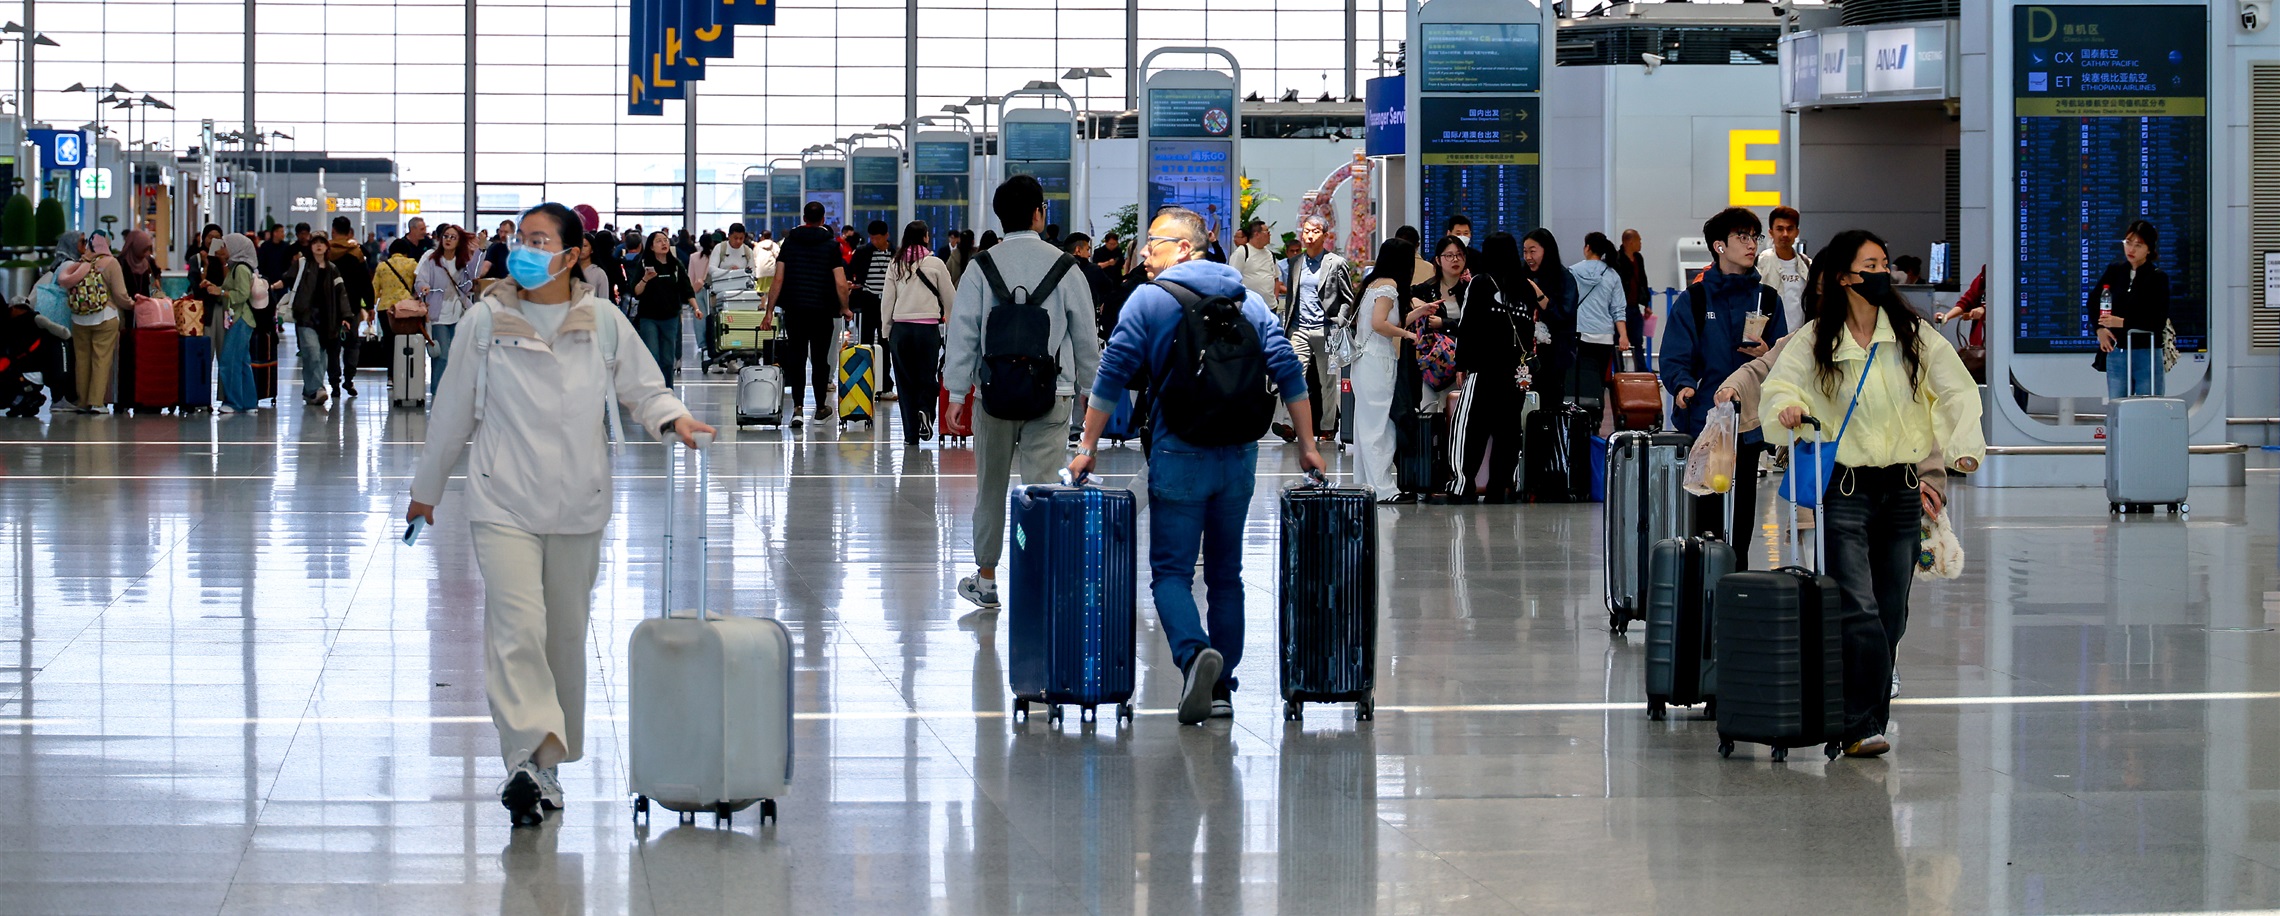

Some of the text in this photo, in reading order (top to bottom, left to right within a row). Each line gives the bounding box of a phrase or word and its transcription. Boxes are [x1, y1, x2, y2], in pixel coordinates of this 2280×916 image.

[2028, 6, 2058, 42] D
[2063, 24, 2100, 35] 值机区
[666, 28, 700, 66] K
[2054, 49, 2118, 64] CX 国泰航空
[653, 53, 676, 87] L
[1876, 48, 1896, 71] ANA
[2056, 73, 2148, 88] ET 埃塞俄比亚航空
[1469, 109, 1500, 117] 国内出发
[1728, 129, 1781, 206] E
